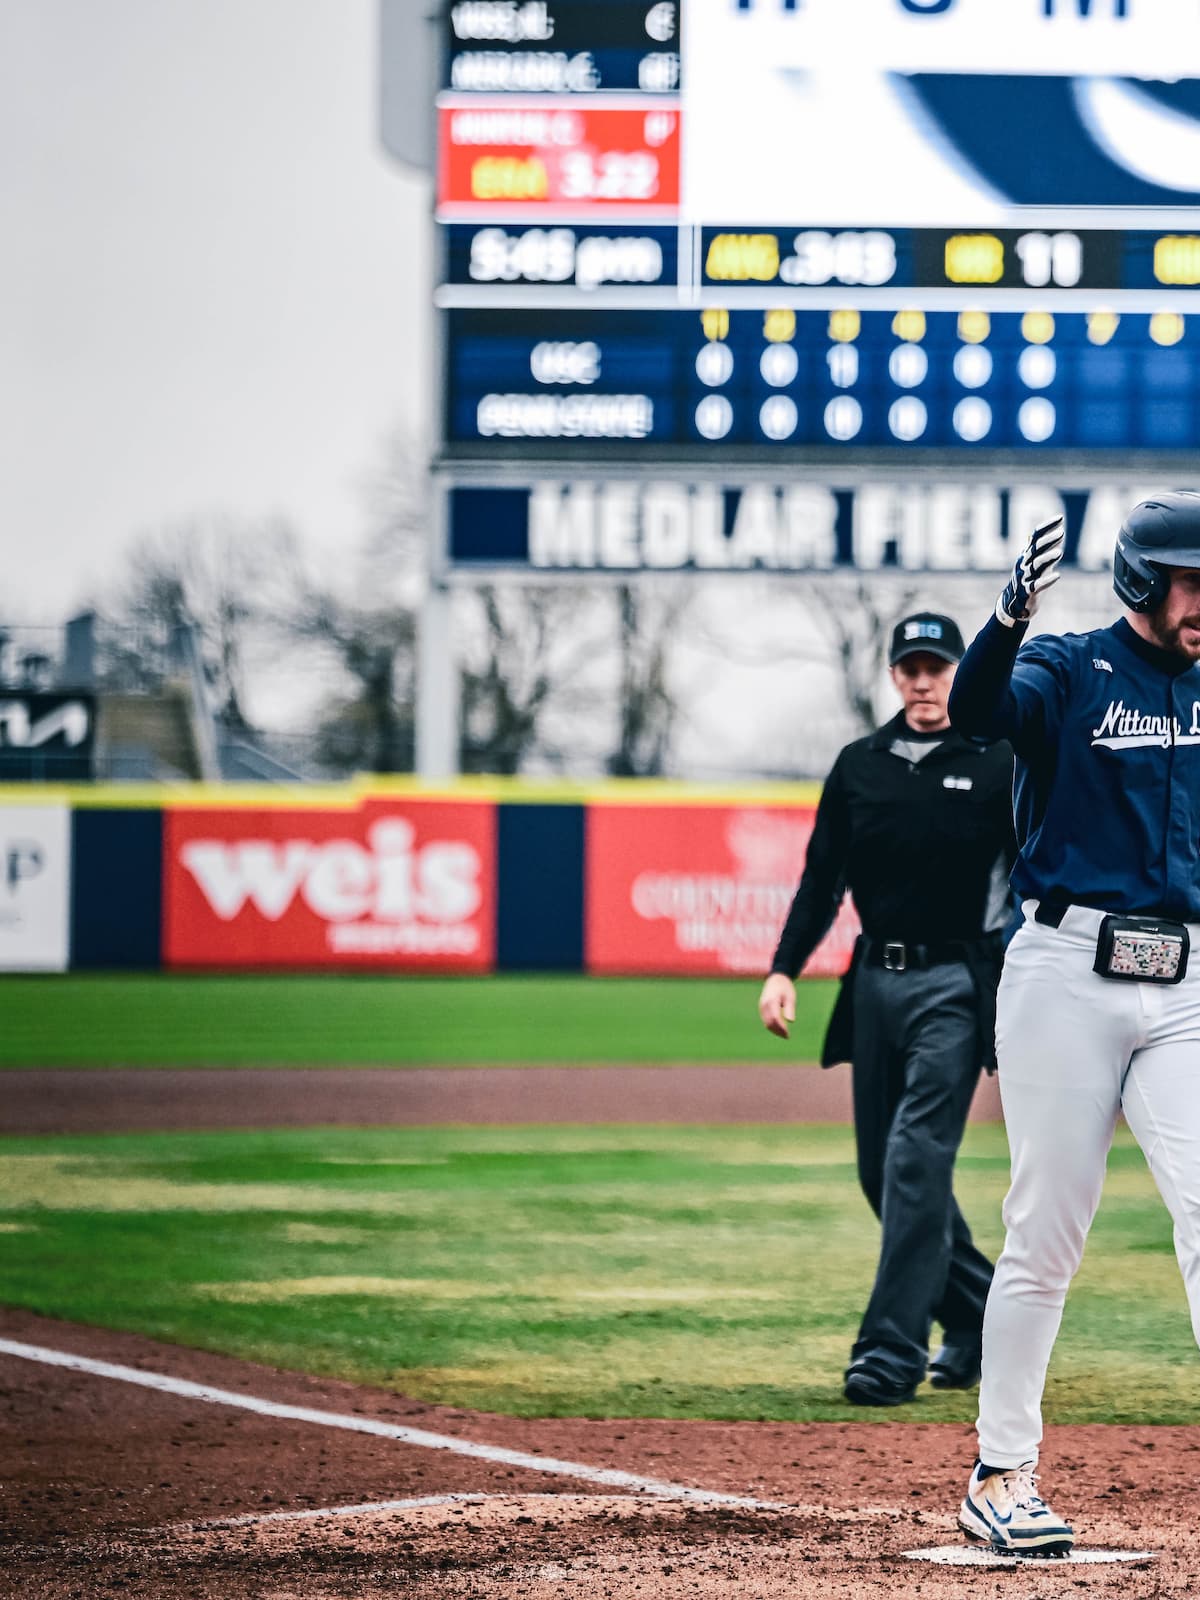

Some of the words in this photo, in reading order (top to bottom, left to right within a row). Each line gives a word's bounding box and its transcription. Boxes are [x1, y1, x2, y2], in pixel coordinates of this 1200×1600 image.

[1015, 231, 1083, 287] 11
[528, 482, 838, 570] MEDLAR
[852, 483, 1066, 572] FIELD
[1093, 700, 1181, 748] Nittany
[180, 817, 482, 922] weis
